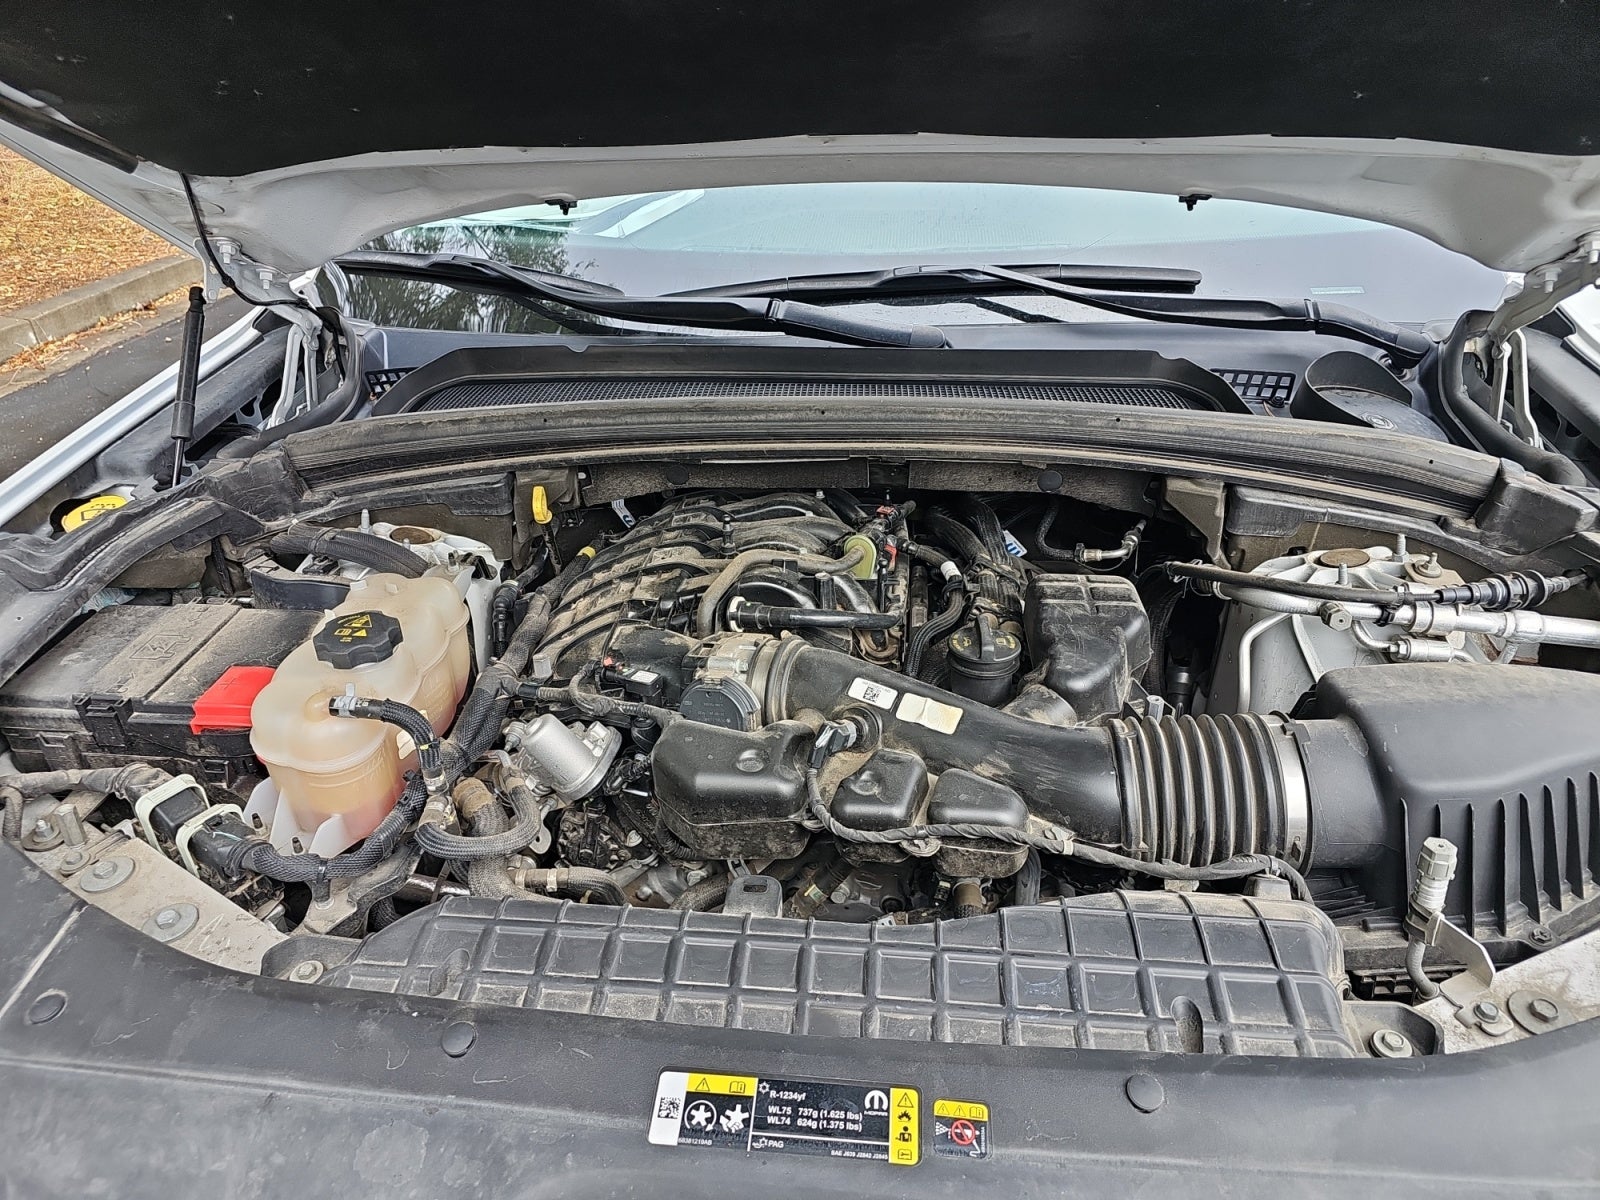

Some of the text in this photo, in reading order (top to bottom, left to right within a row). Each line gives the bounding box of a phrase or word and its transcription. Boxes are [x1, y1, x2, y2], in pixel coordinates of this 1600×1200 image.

[770, 1090, 806, 1102] R-1234yf
[768, 1105, 862, 1122] WL75 737g (1.625 lbs)
[767, 1116, 862, 1132] WL74 624g (1.375 lbs)
[768, 1140, 784, 1148] PAG
